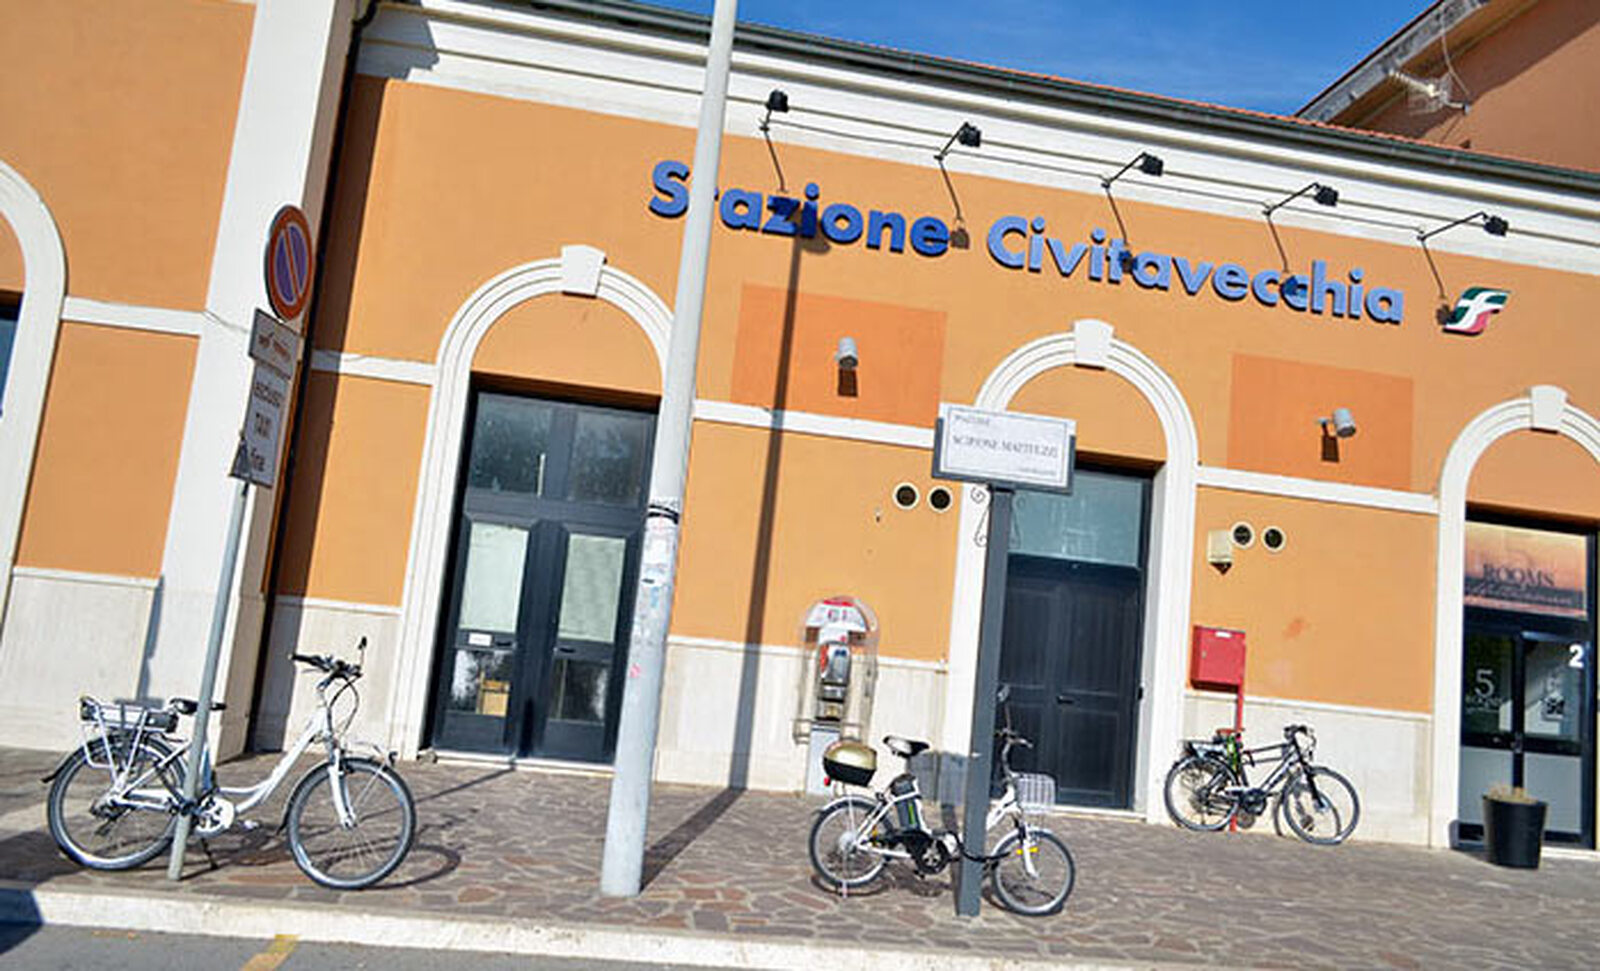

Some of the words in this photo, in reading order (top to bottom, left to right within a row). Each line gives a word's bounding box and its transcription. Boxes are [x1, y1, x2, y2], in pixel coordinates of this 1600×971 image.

[648, 160, 951, 256] Sazione
[986, 215, 1404, 325] Civitavecchia
[1569, 644, 1584, 668] 2
[1475, 669, 1494, 698] 5
